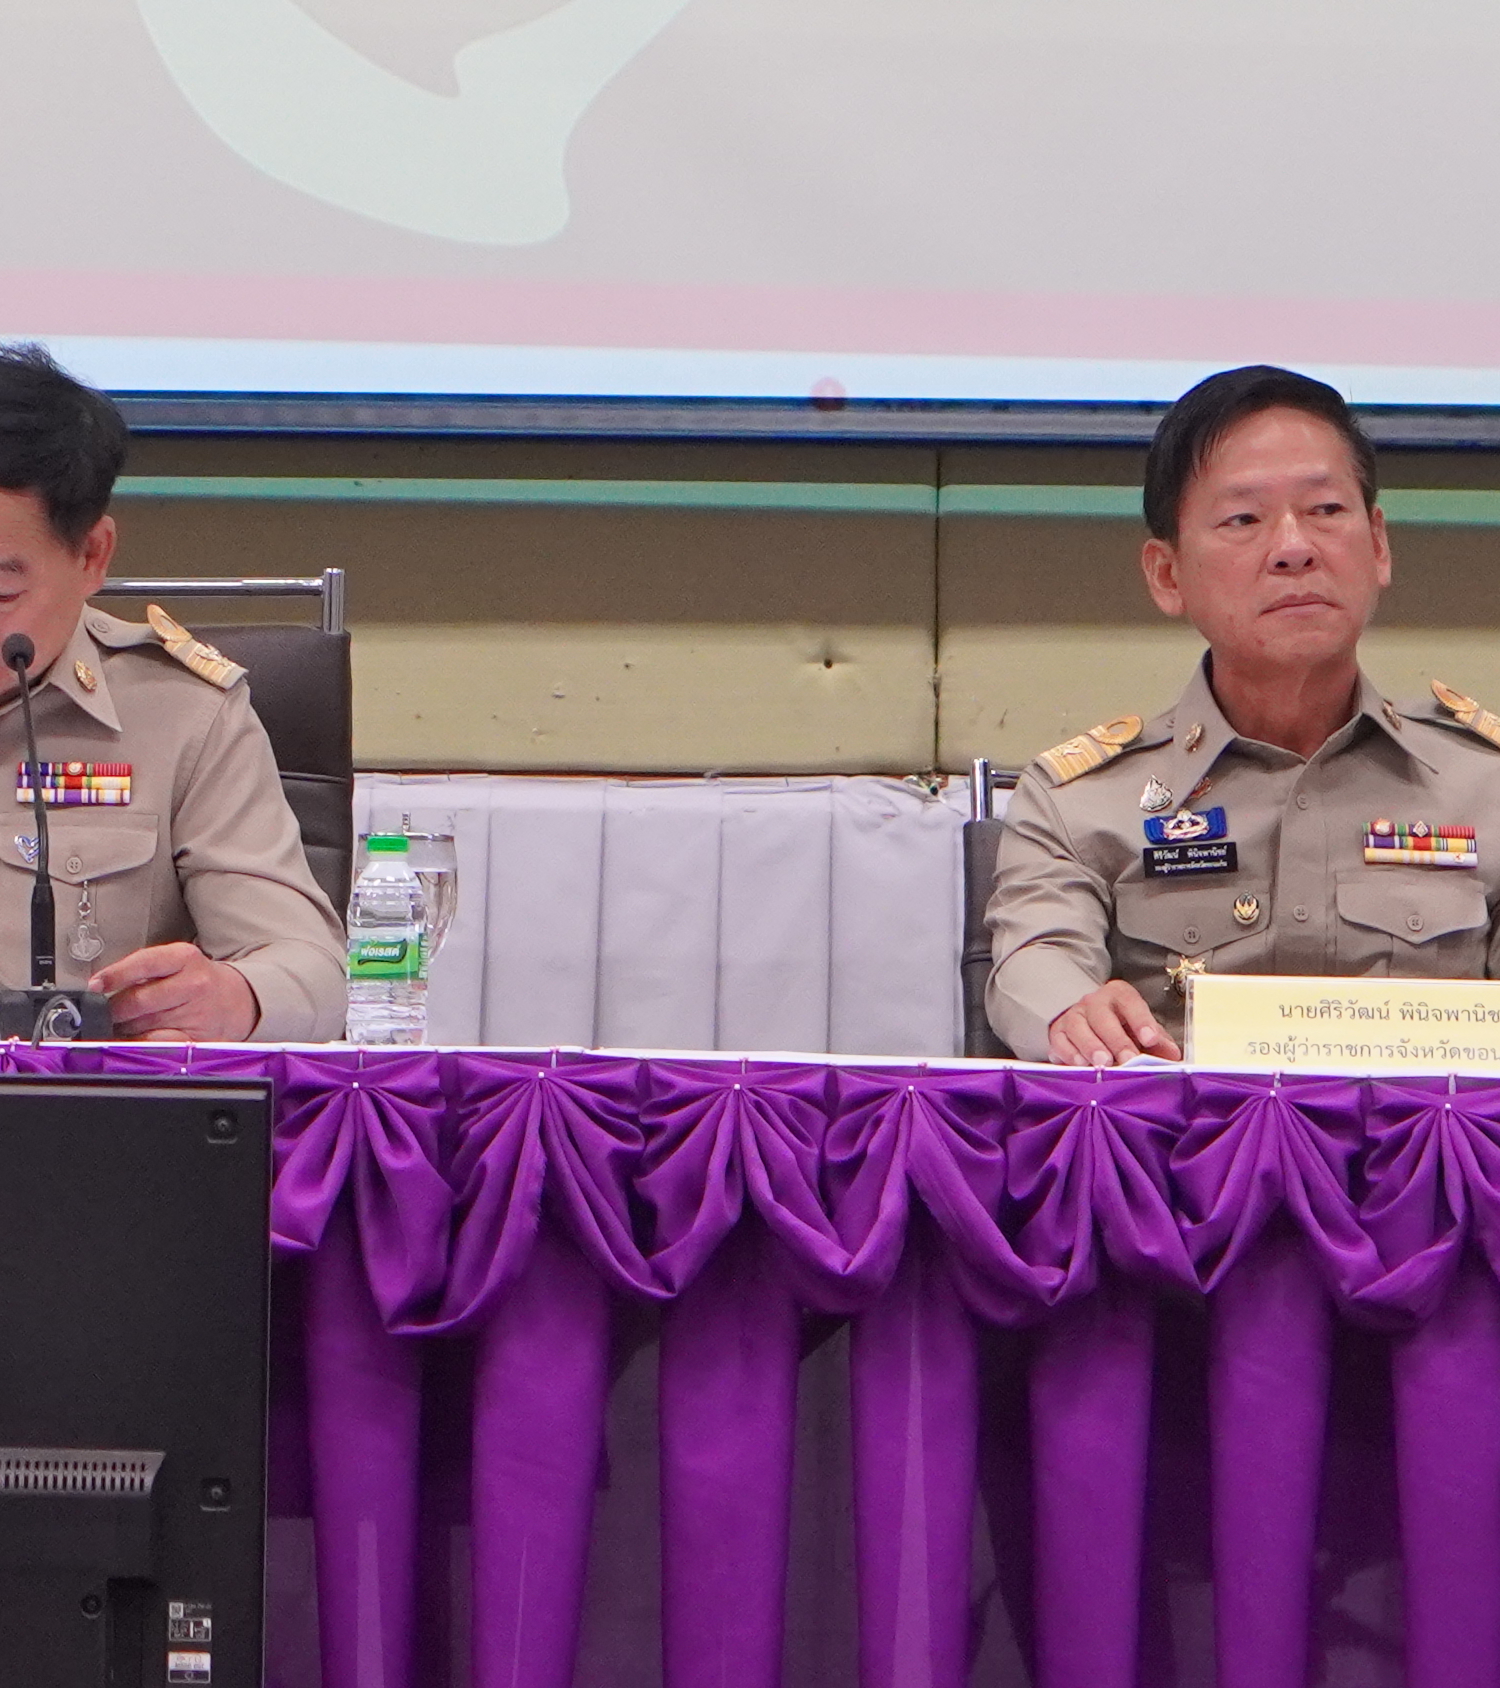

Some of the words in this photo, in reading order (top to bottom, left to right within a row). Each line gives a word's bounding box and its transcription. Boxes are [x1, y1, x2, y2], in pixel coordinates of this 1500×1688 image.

[1278, 999, 1392, 1023] นายศิริวัฒน์
